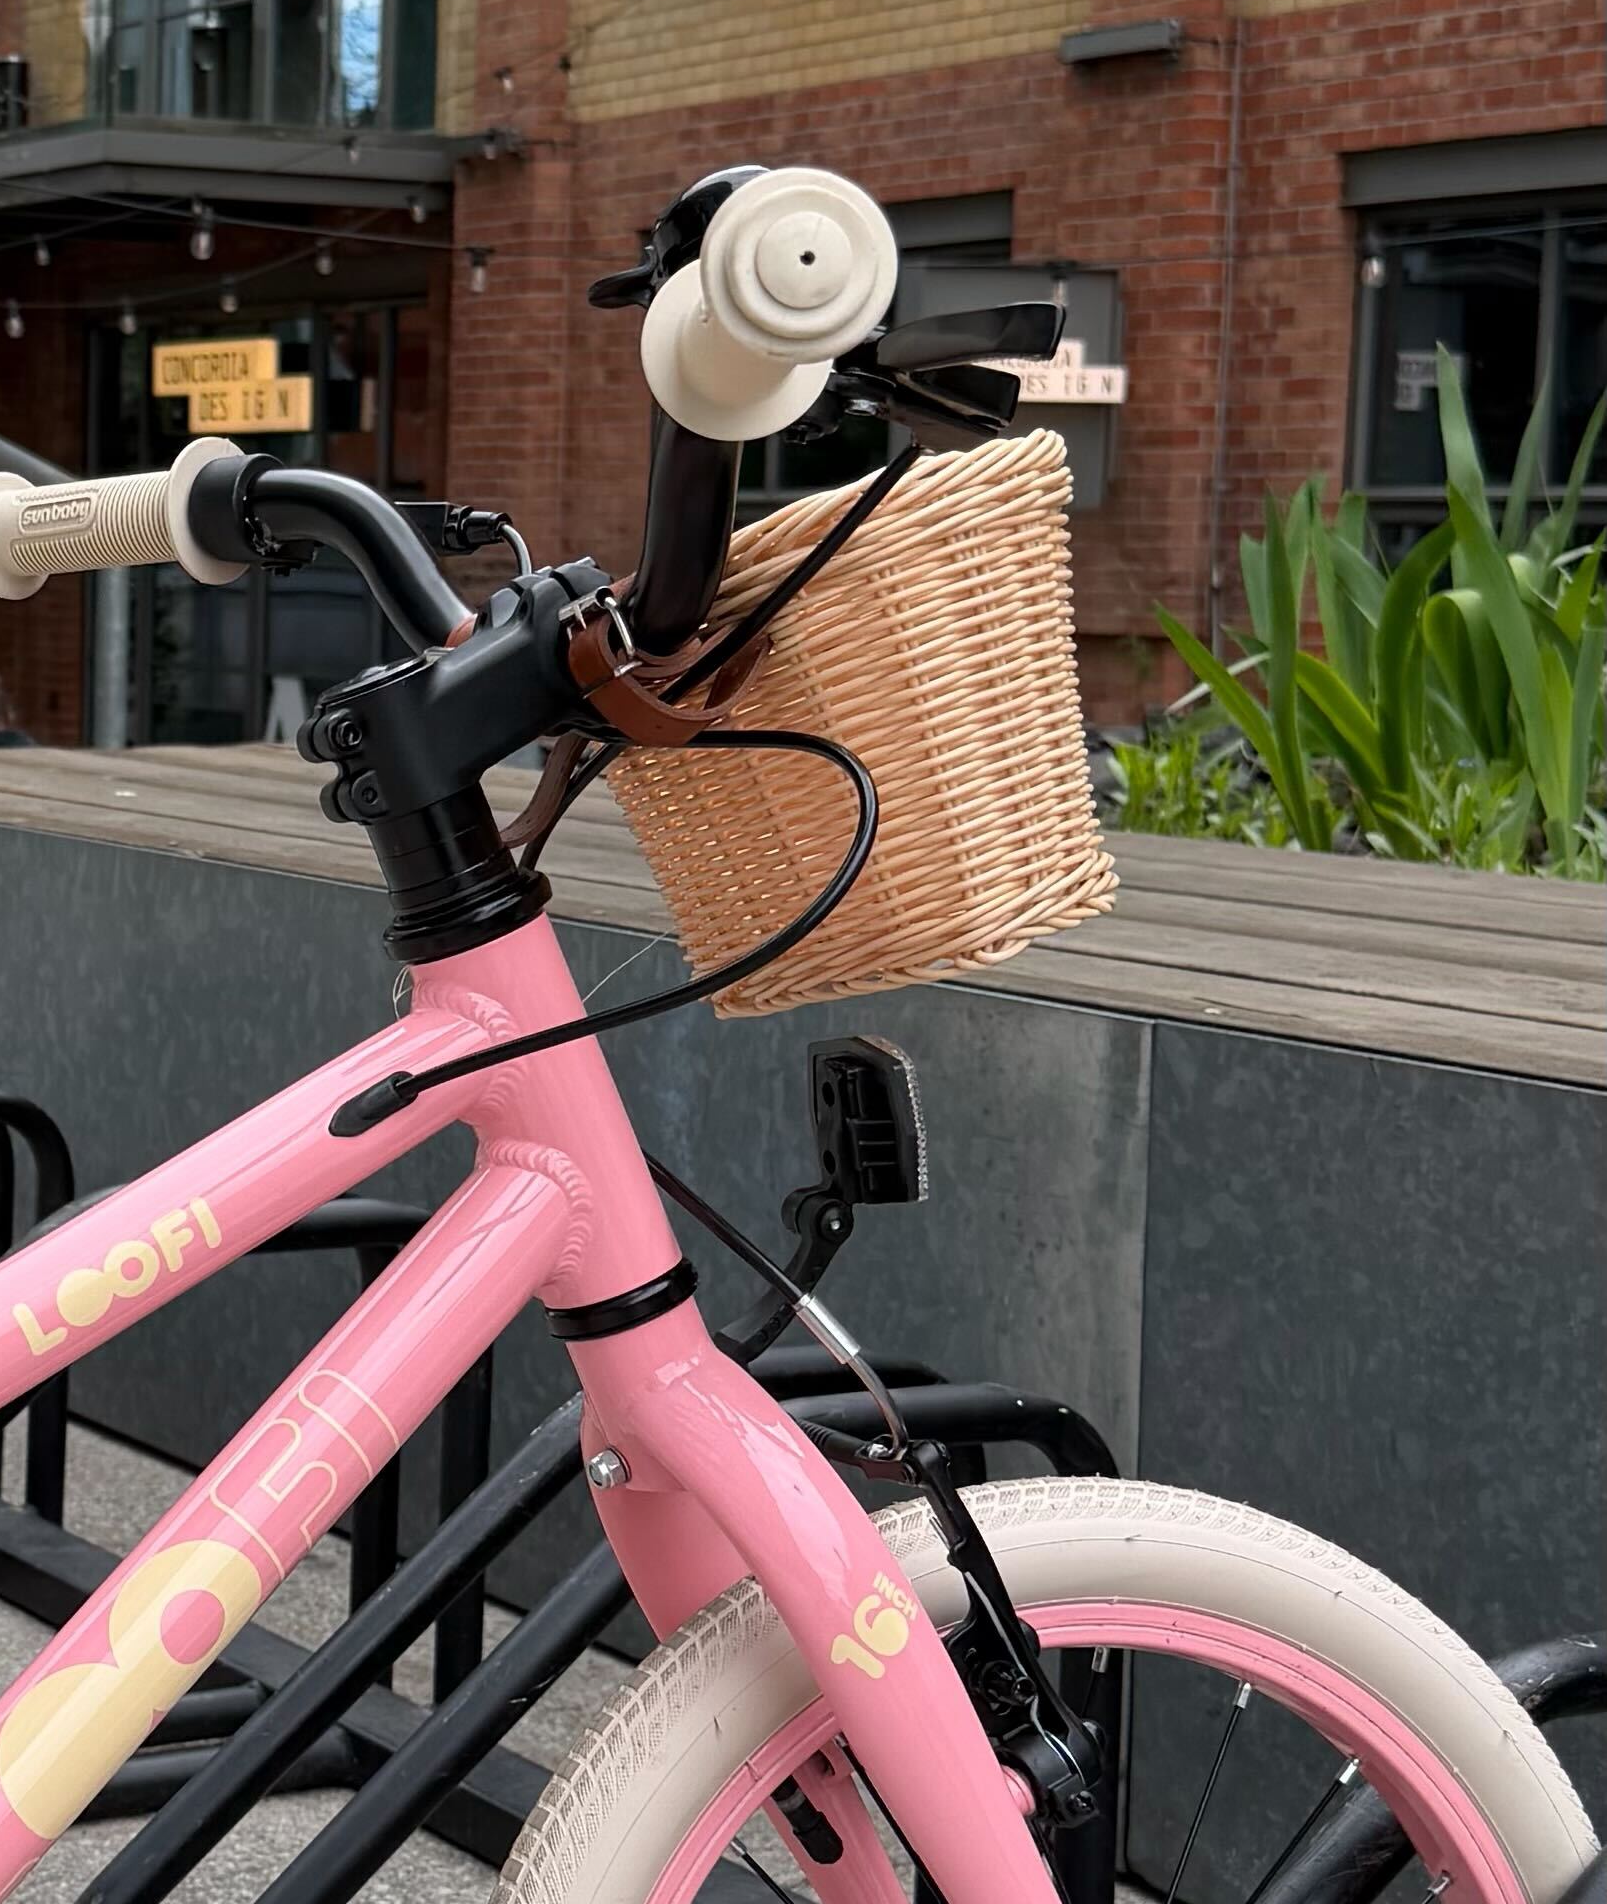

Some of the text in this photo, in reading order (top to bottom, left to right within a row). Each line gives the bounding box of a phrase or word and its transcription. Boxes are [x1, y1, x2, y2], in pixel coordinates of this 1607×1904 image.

[12, 1196, 223, 1357] LOOFI
[830, 1594, 909, 1680] 16
[872, 1570, 919, 1621] INCH
